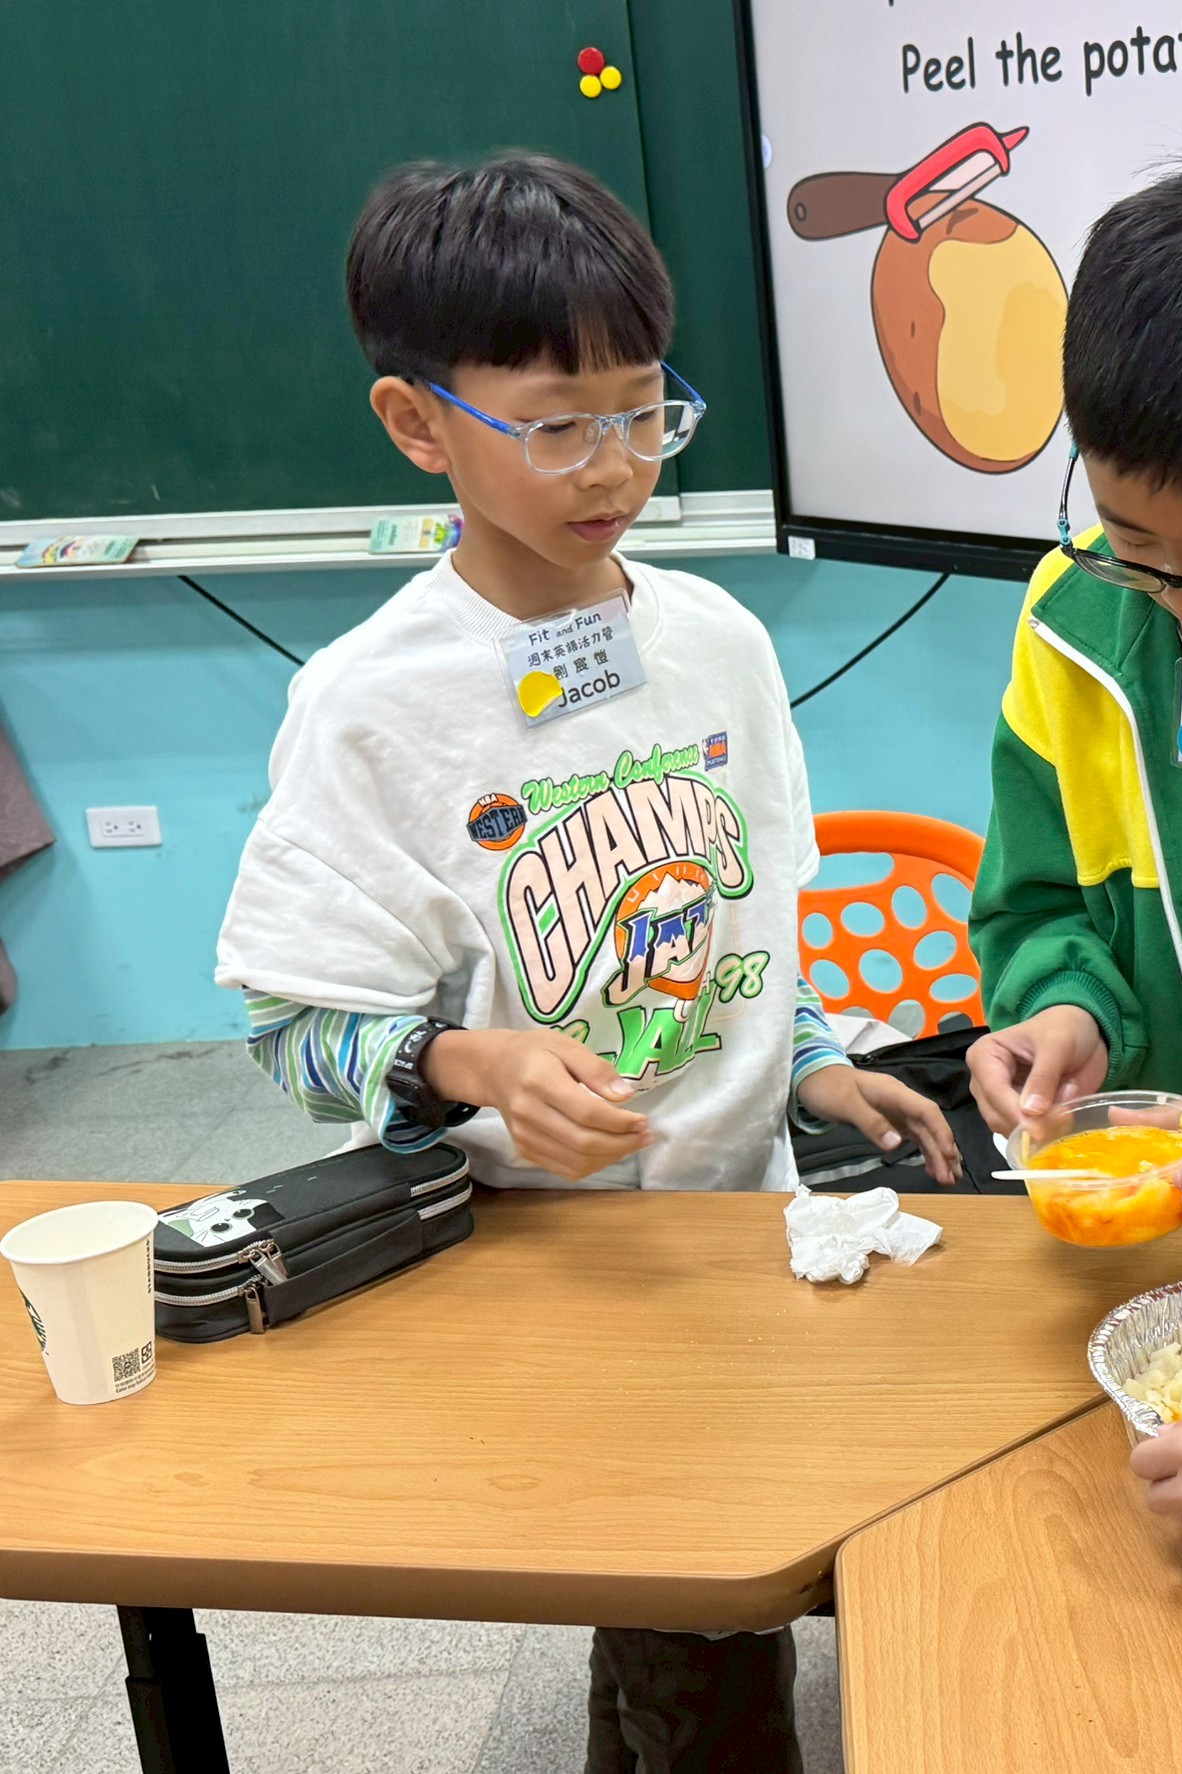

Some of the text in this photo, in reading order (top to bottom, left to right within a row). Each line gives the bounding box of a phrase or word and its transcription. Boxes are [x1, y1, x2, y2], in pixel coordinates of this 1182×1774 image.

[902, 36, 976, 94] Peel
[995, 31, 1063, 87] the
[528, 612, 602, 647] Fit and Fun
[558, 669, 621, 709] Jacob
[520, 743, 700, 816] Western Conference
[468, 806, 527, 840] WESTERN
[506, 776, 745, 1015] CHAMPS
[715, 952, 770, 1003] 98
